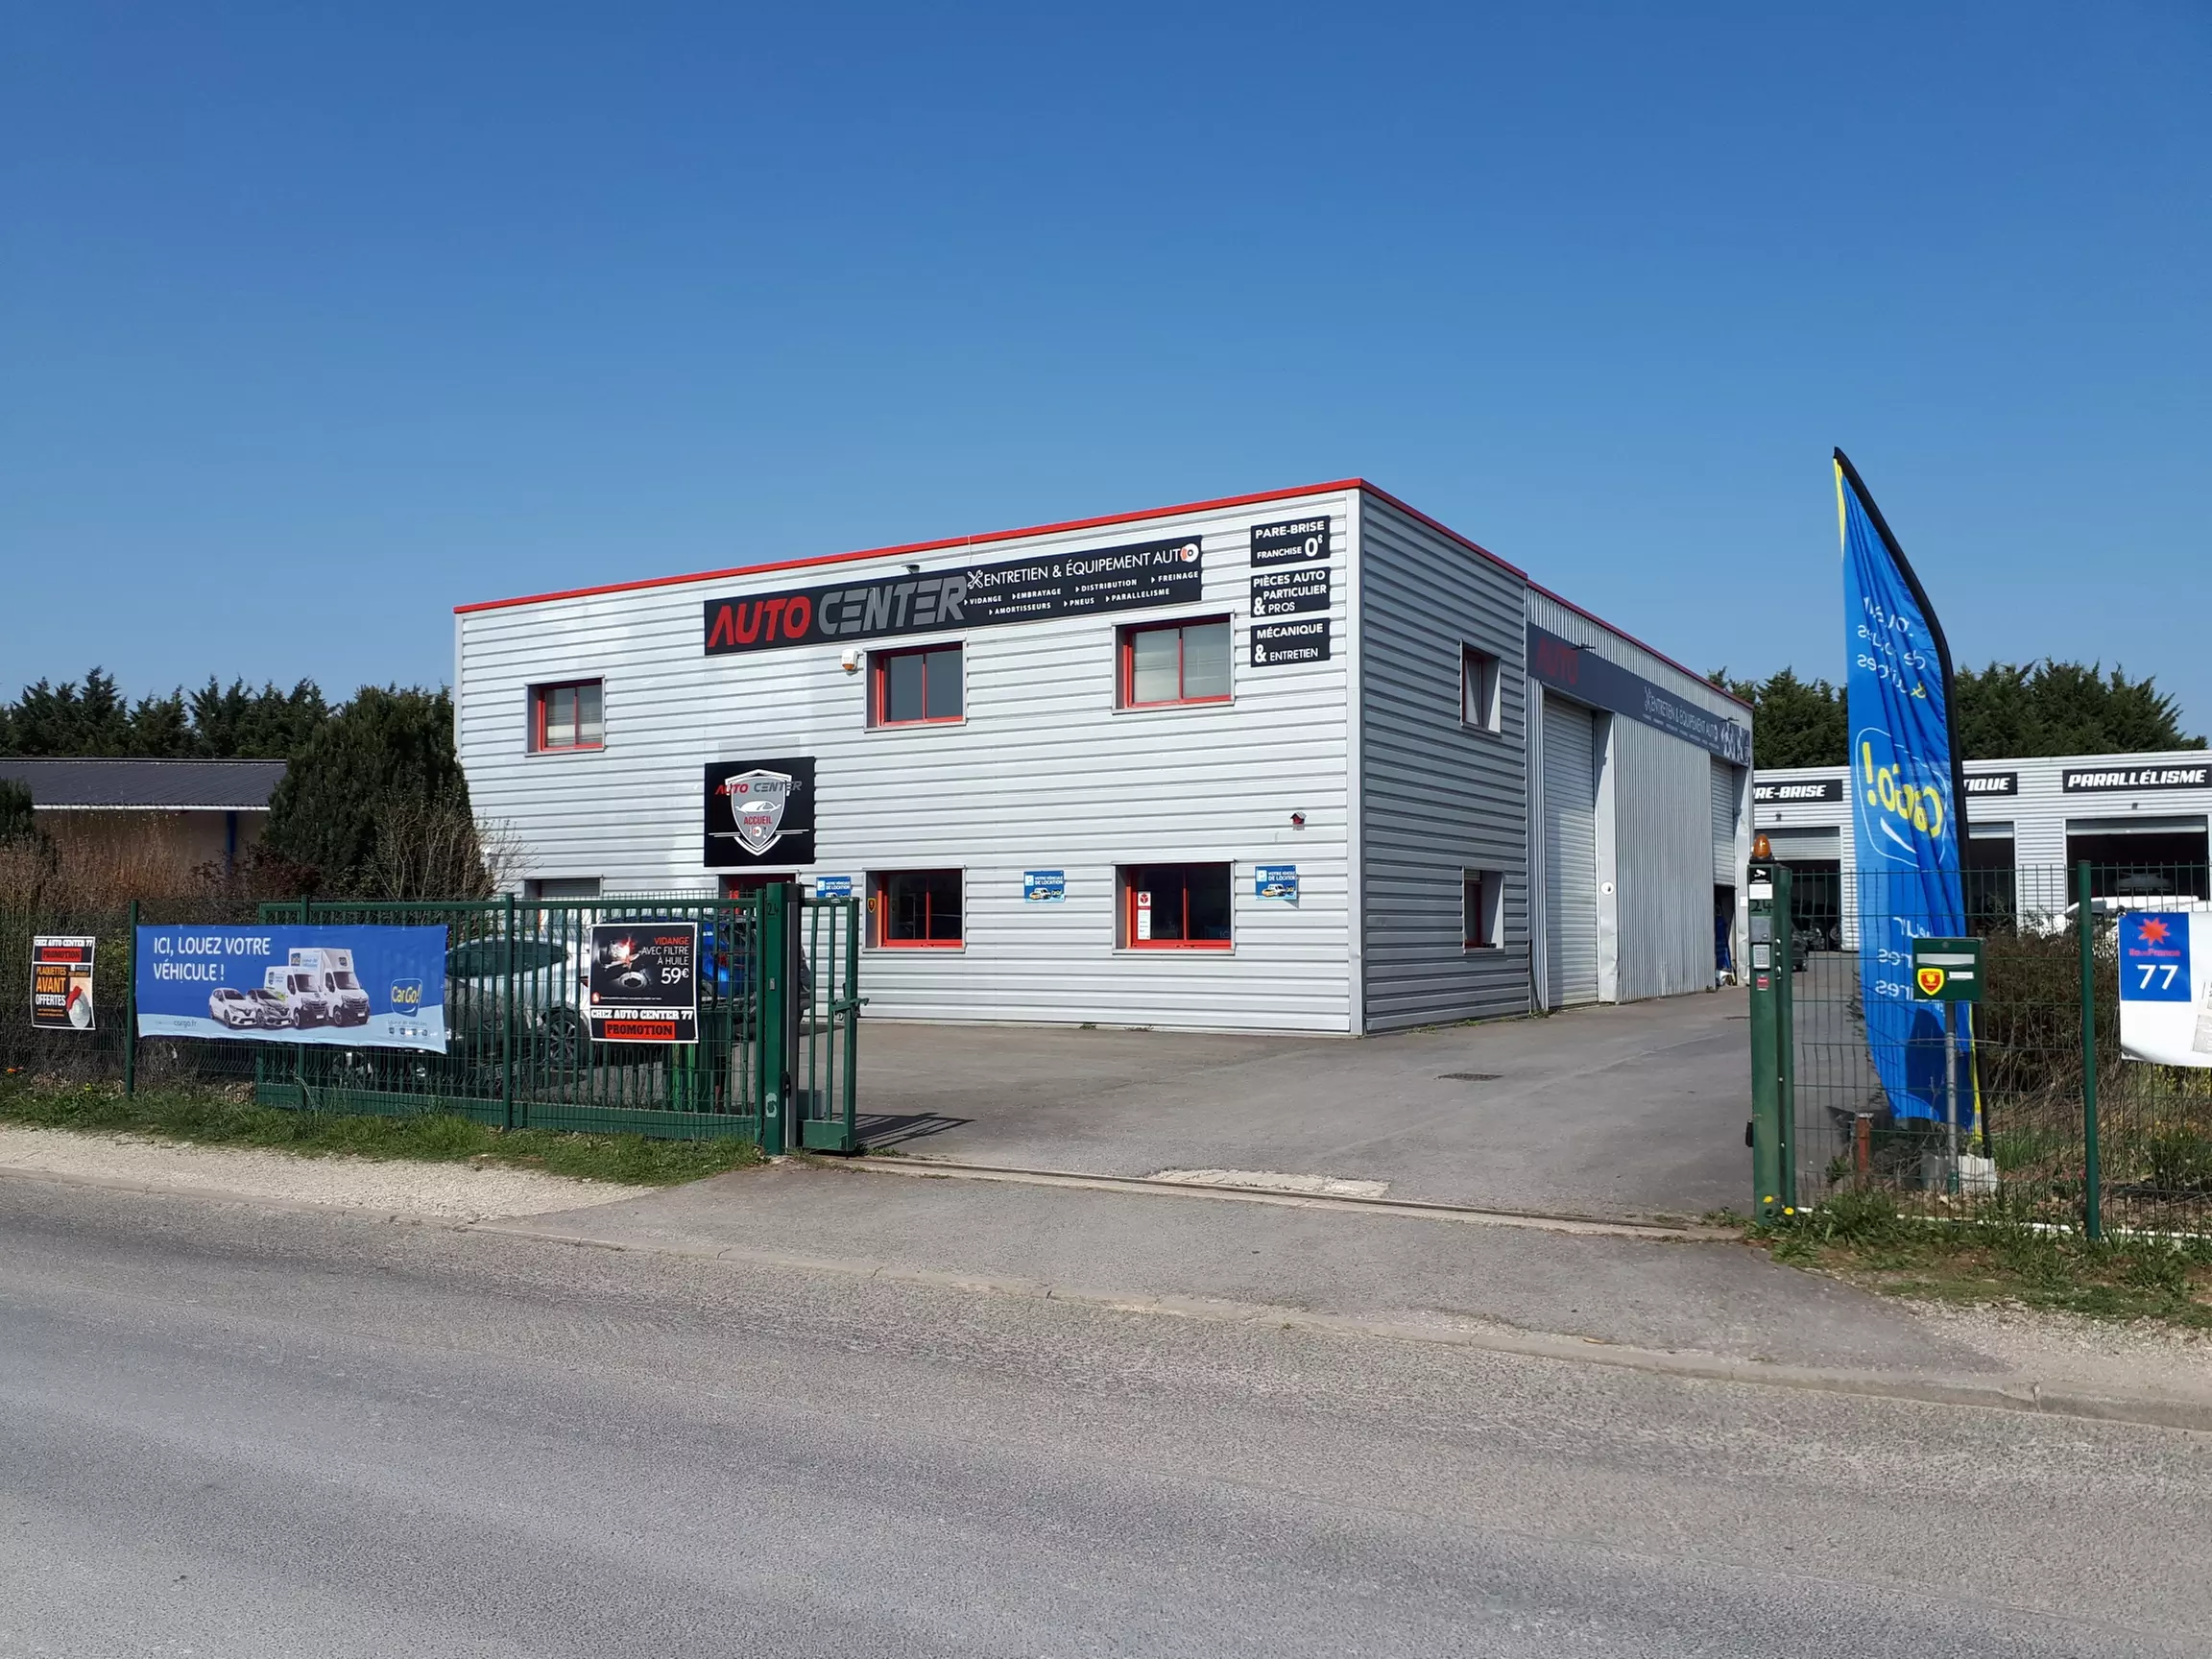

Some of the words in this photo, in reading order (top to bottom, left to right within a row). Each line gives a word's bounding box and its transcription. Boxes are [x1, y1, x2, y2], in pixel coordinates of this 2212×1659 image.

[1256, 520, 1324, 539] PARE-BRISE
[1257, 546, 1302, 560] FRANCHISE
[984, 565, 1049, 588] ENTRETIEN
[1052, 565, 1062, 578] &
[1066, 552, 1150, 576] ÉQUIPEMENT
[1253, 573, 1289, 588] PIÈCES
[1293, 570, 1325, 584] AUTO
[970, 595, 1002, 605] VIDANGE
[1017, 588, 1062, 600] EMBRAYAGE
[1081, 579, 1138, 592] DISTRIBUTION
[1158, 571, 1198, 582] FREINAGE
[1263, 584, 1327, 600] PARTICULIER
[707, 595, 812, 648] AUTO
[818, 576, 967, 635] CENTER
[995, 602, 1051, 614] AMORTISSEURS
[1070, 597, 1094, 607] PNEUS
[1253, 597, 1265, 615] &
[1268, 602, 1295, 613] PROS
[1257, 623, 1323, 639] MÉCANIQUE
[1255, 644, 1266, 662] &
[1270, 648, 1318, 661] ENTRETIEN
[2068, 769, 2207, 787] PARALLÉLISME
[714, 782, 749, 795] AUTO
[754, 781, 803, 793] CENTER
[1754, 784, 1827, 799] RE-BRISE
[744, 815, 772, 825] ACCUEIL
[1750, 901, 1773, 913] 24
[154, 937, 174, 956] ICI,
[178, 936, 222, 954] LOUEZ
[225, 937, 271, 955] VOTRE
[654, 937, 689, 946] VIDANGE
[642, 947, 662, 955] AVEC
[663, 946, 689, 955] FILTRE
[665, 956, 689, 965] HUILE
[36, 966, 66, 975] PLAQUETTES
[154, 958, 217, 981] VÉHICULE
[2137, 965, 2178, 990] 77
[36, 976, 66, 993] AVANT
[36, 994, 66, 1006] OFFERTES
[591, 1010, 613, 1019] CHEZ
[613, 1010, 638, 1019] AUTO
[640, 1010, 680, 1020] CENTER
[681, 1010, 693, 1020] 77
[607, 1024, 672, 1035] PROMOTION
